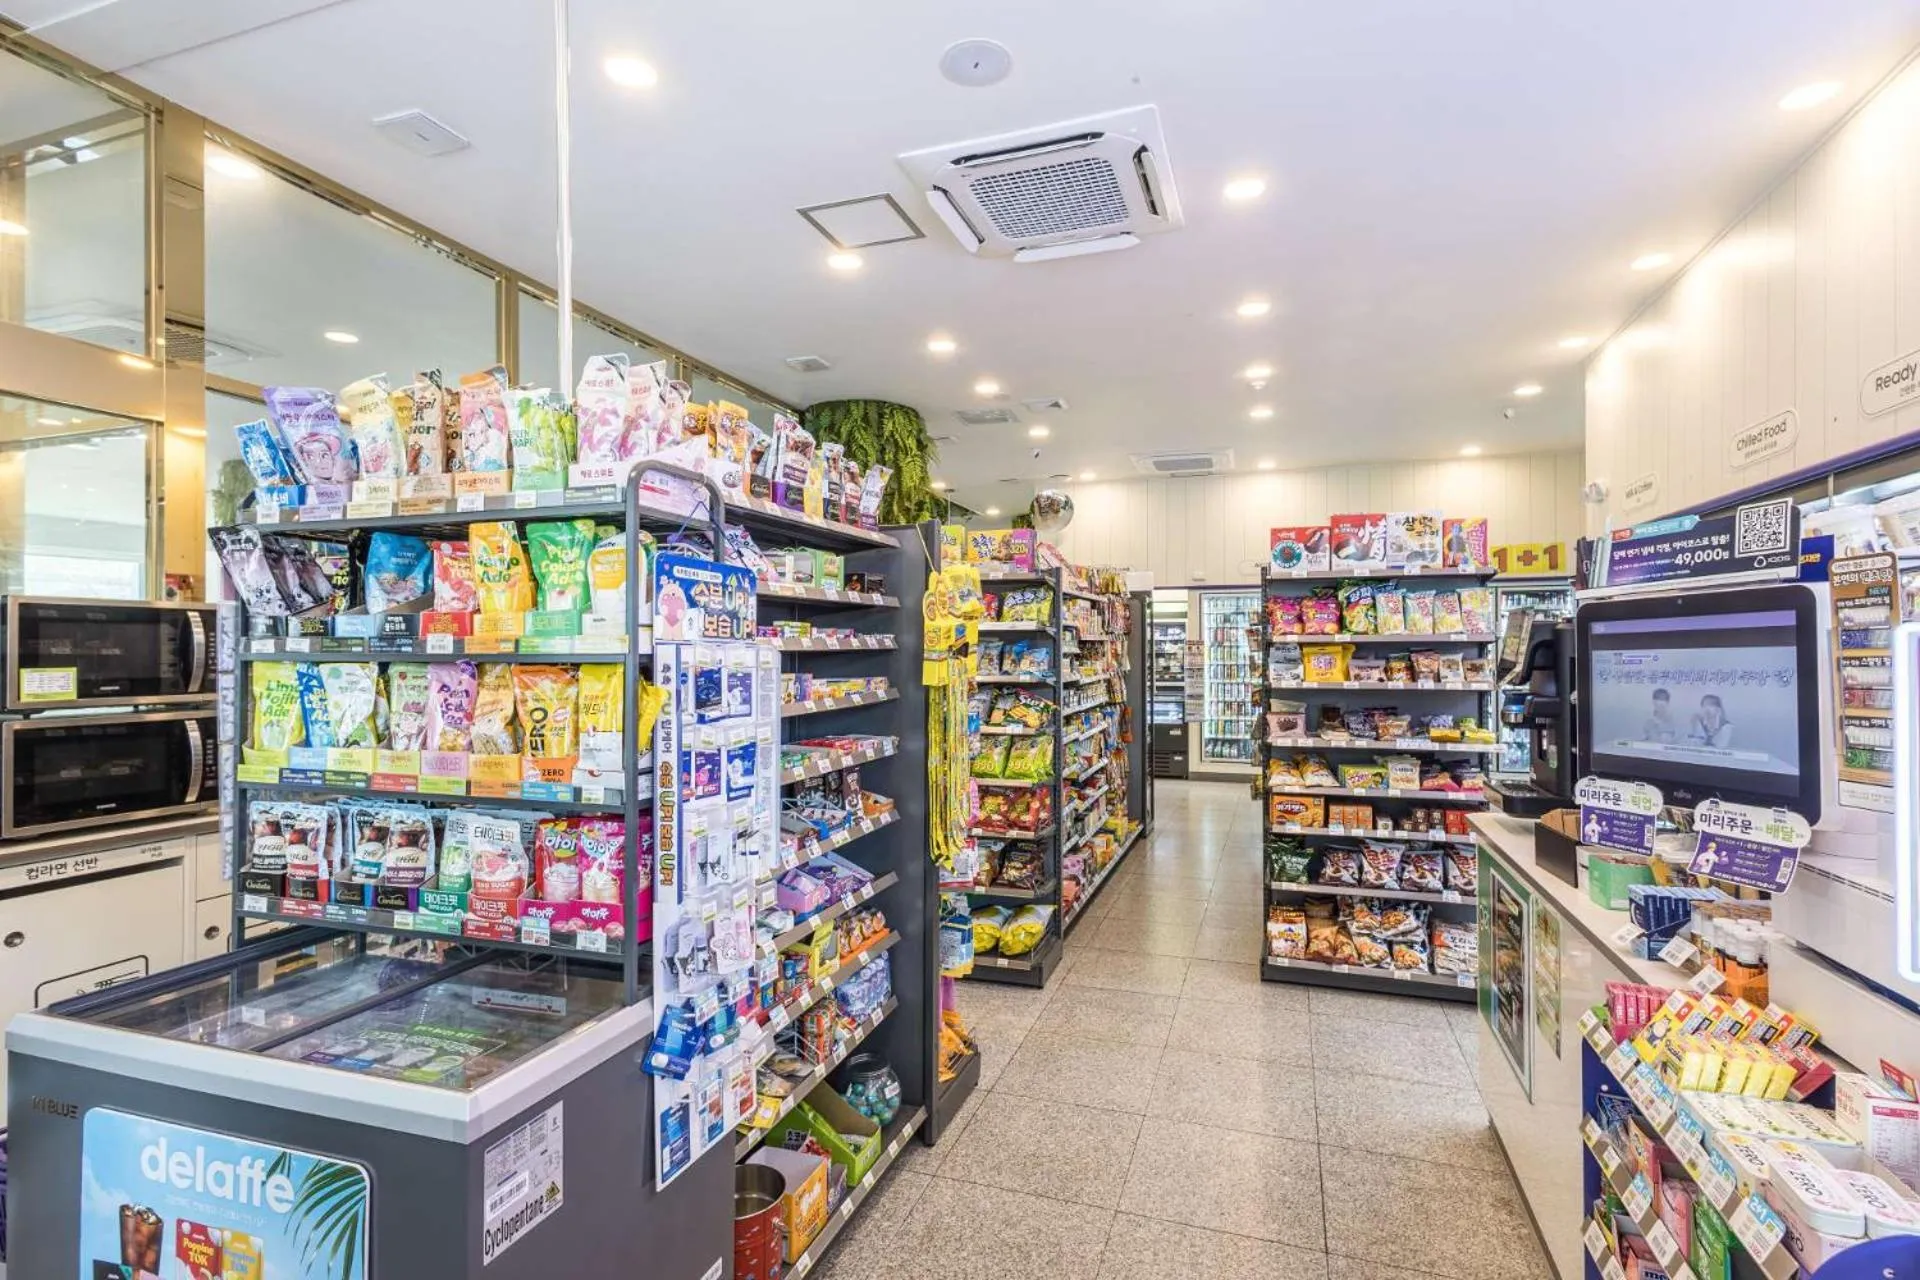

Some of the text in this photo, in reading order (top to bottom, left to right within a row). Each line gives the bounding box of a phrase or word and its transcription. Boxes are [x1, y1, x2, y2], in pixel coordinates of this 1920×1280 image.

[1875, 362, 1918, 391] Ready
[1736, 427, 1763, 452] Chilled
[1763, 418, 1787, 441] Food
[1492, 544, 1560, 573] 1+1
[1641, 545, 1655, 557] 냄새
[1673, 537, 1709, 550] 아이코스로
[1711, 534, 1731, 546] 탈출!
[1675, 548, 1730, 566] 49,000원
[480, 569, 511, 584] Ade
[1868, 587, 1889, 595] NEW
[263, 706, 290, 718] Ade
[529, 707, 548, 757] ERO
[661, 719, 673, 754] 립케어
[541, 768, 565, 777] ZERO
[660, 790, 675, 822] UP!
[1580, 788, 1651, 811] 미리주문 픽업
[1699, 813, 1796, 843] 미리주문 배달
[25, 856, 99, 880] 컵라면 선반
[660, 853, 675, 886] UP!
[140, 1137, 296, 1214] delaffe
[484, 1194, 545, 1256] Cyclopentane
[182, 1235, 215, 1257] Popping
[188, 1250, 209, 1267] TOK
